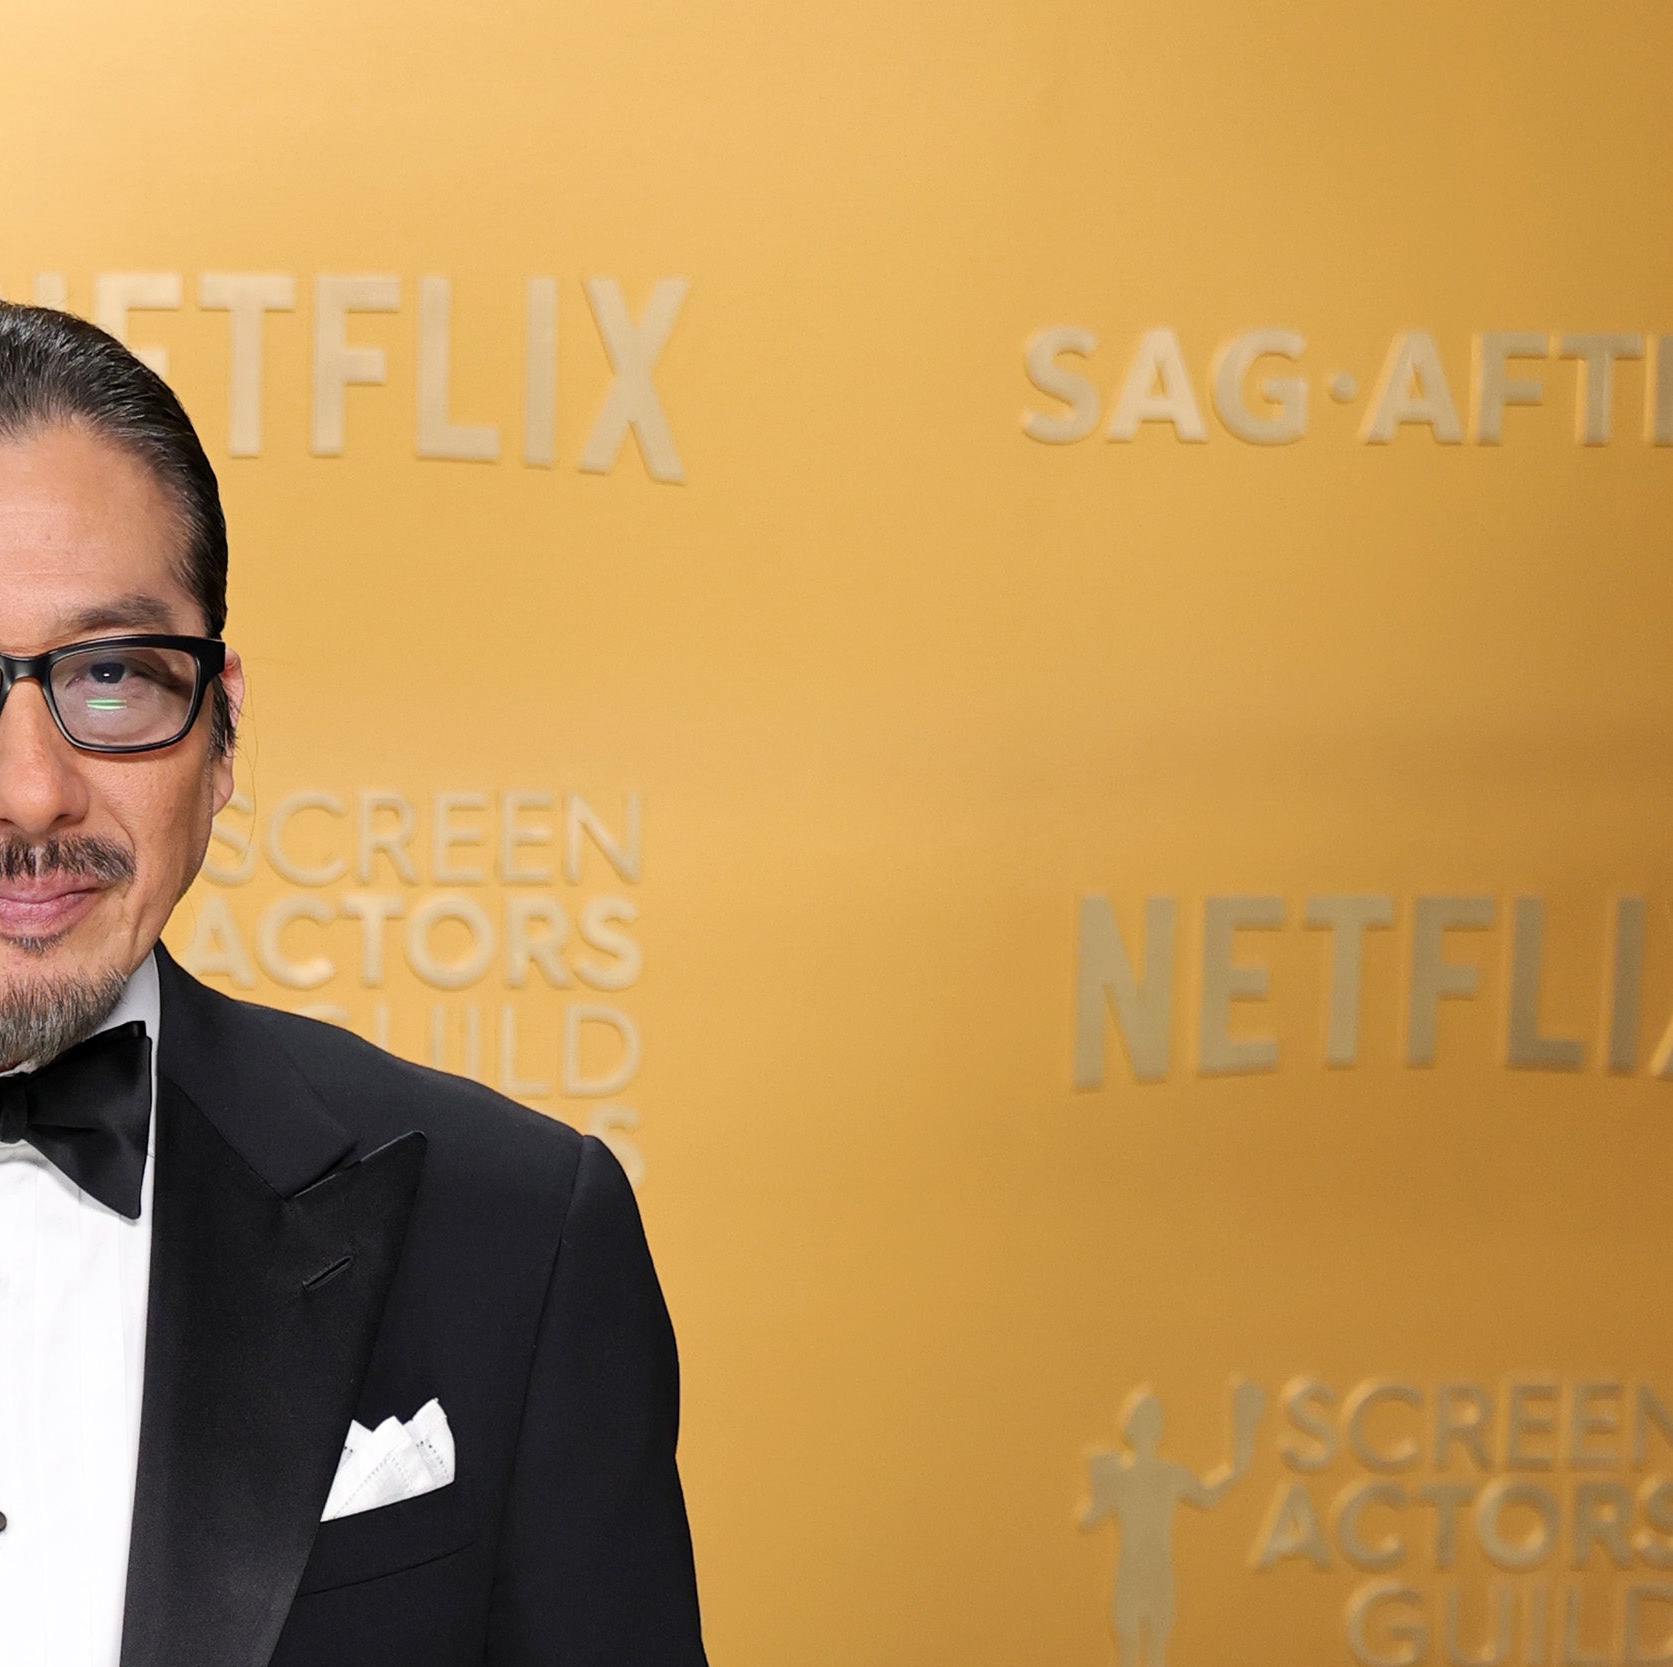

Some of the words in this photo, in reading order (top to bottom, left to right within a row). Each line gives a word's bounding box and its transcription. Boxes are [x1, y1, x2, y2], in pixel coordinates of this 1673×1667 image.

[1020, 324, 1673, 447] SAG·AFT
[201, 789, 641, 887] SCREEN
[182, 892, 643, 990] ACTORS
[1072, 892, 1673, 1092] NETFLI
